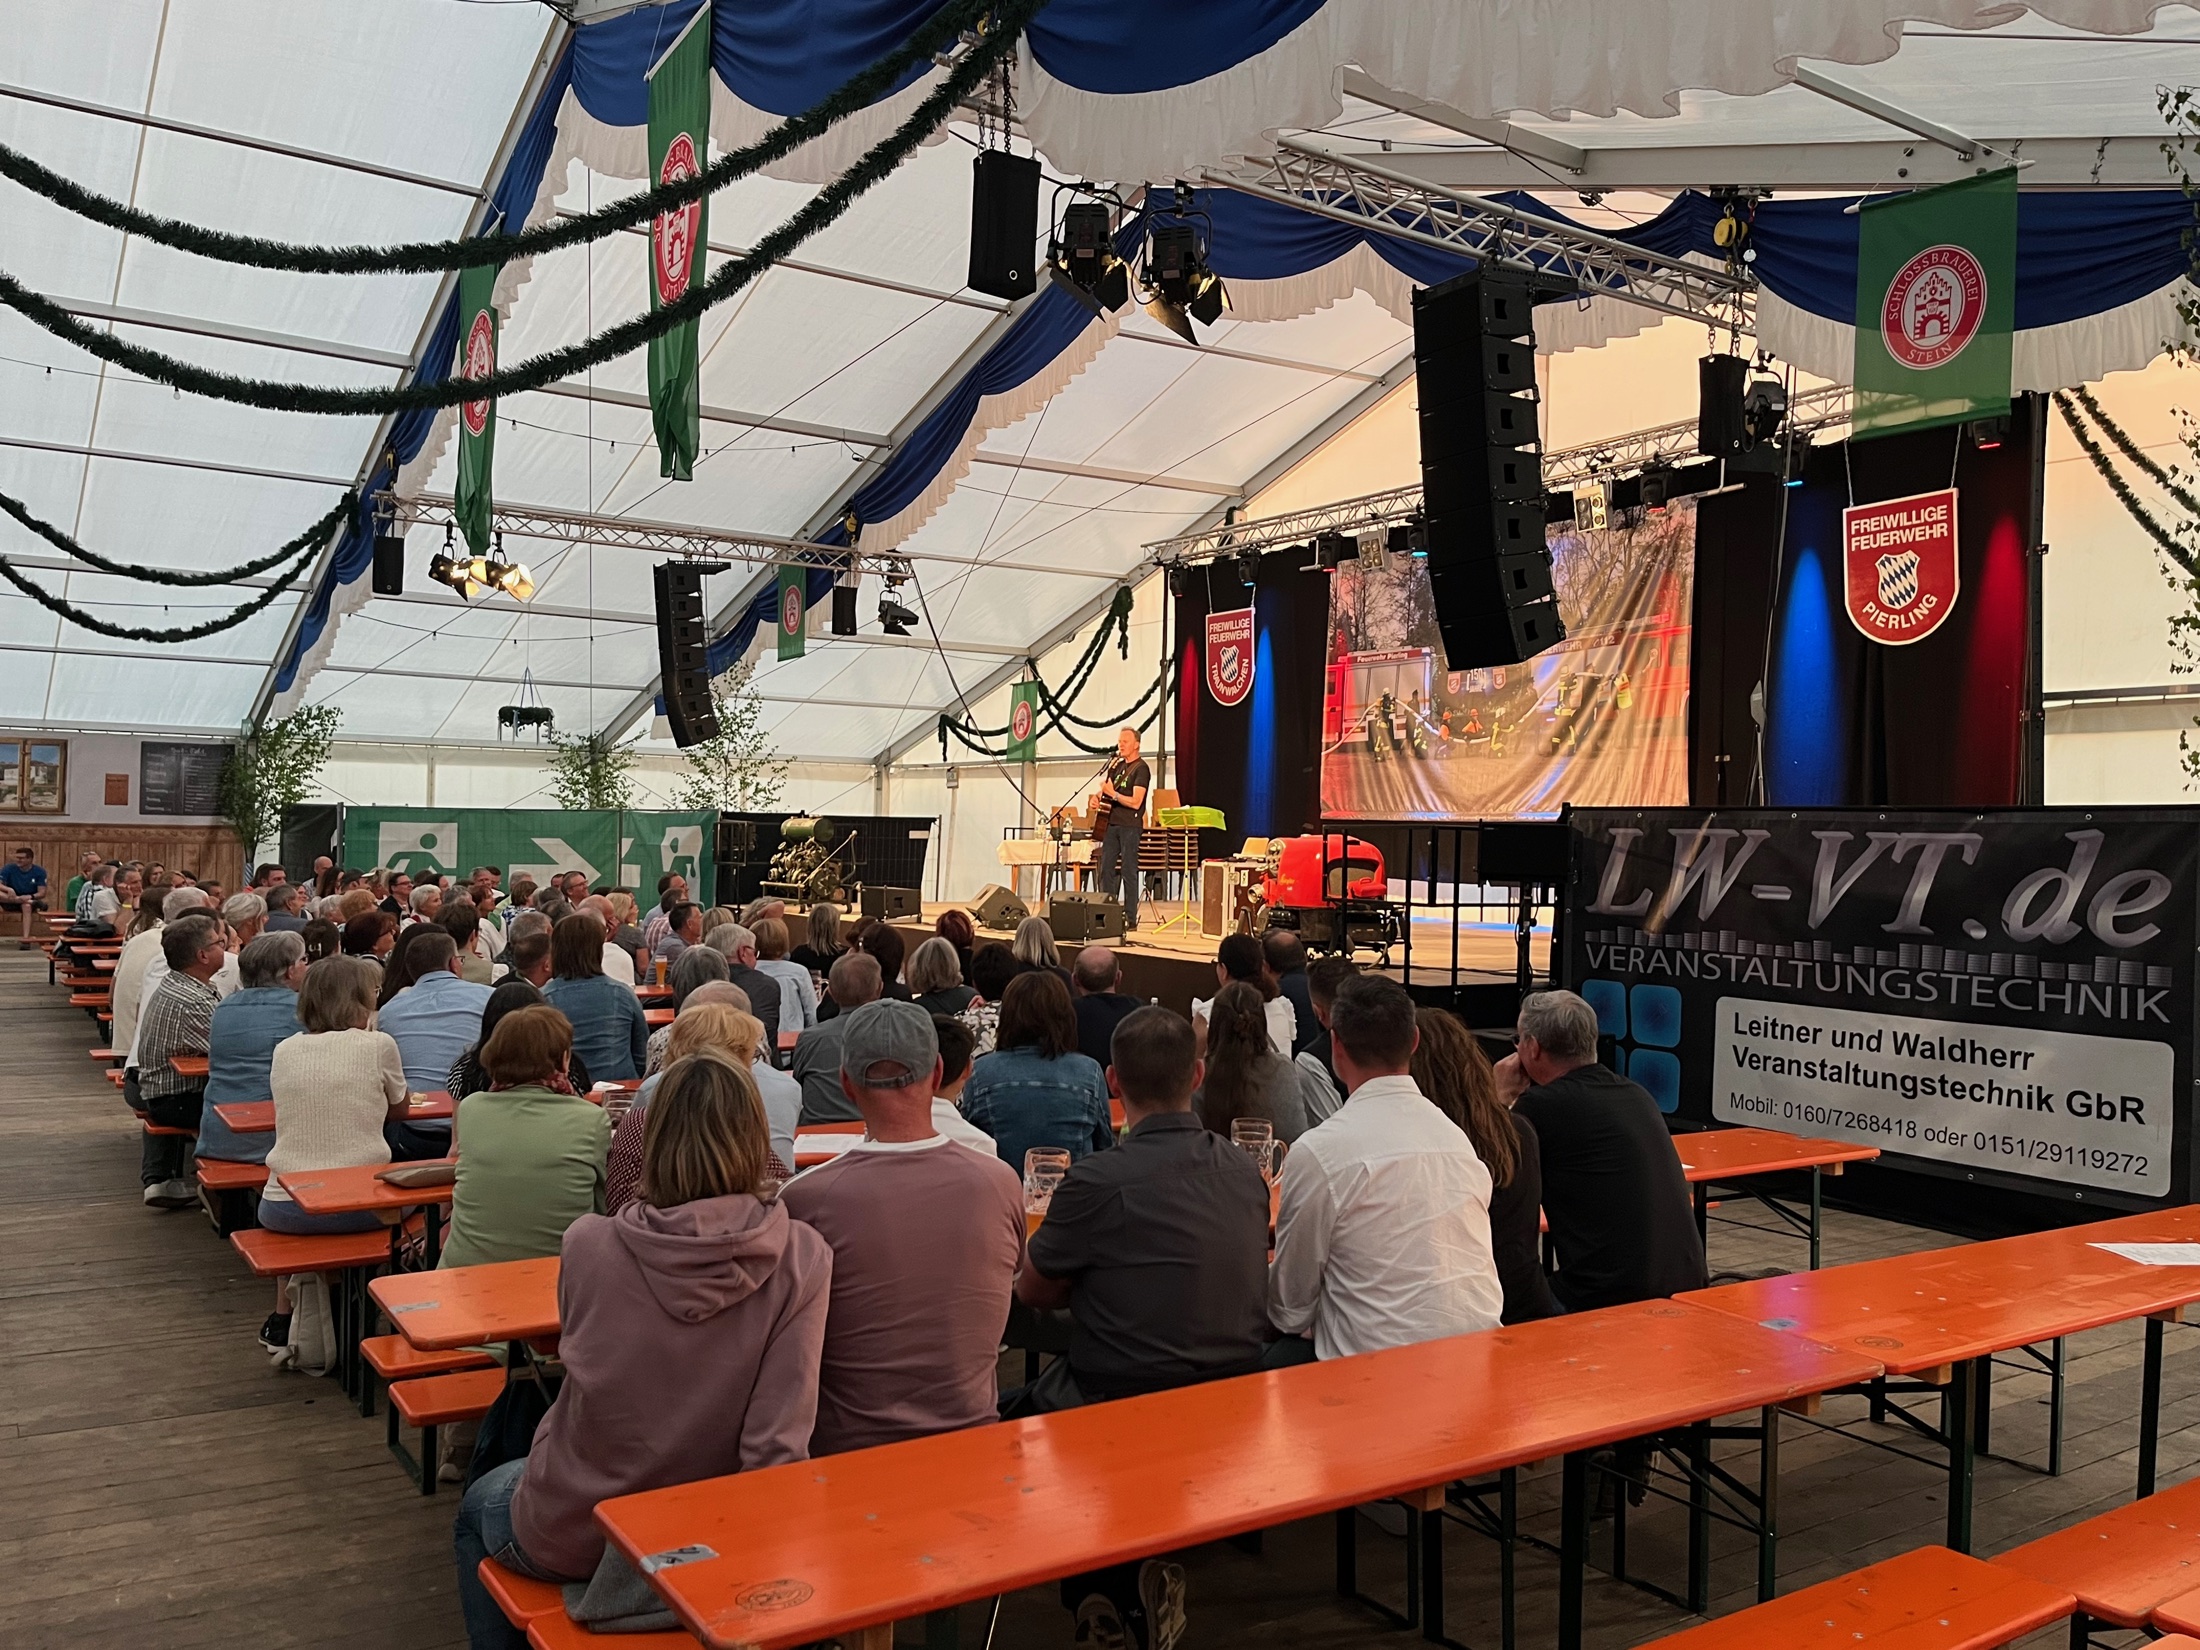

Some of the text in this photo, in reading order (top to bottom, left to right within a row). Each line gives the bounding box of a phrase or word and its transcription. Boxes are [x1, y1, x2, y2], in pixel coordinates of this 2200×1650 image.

[1889, 252, 1979, 320] SCHLOSSBRAUEREI
[1907, 343, 1953, 362] STEIN
[1851, 505, 1948, 535] FREIWILLIGE
[1851, 523, 1948, 552] FEUERWEHR
[1209, 618, 1251, 633] FREIWILLIGE
[1862, 594, 1938, 630] PIERLING
[1209, 629, 1251, 644] FEUERWEHR
[1211, 658, 1249, 697] TRAUNWALCHEN
[1585, 828, 2172, 948] LW-VT.de
[1585, 943, 2171, 1024] VERANSTALTUNGSTECHNIK
[1734, 1012, 2034, 1070] Leitner und Waldherr
[1732, 1045, 2146, 1125] Veranstaltungstechnik GbR
[1730, 1092, 2149, 1177] Mobil: 0160/7268418 oder 0151/29119272
